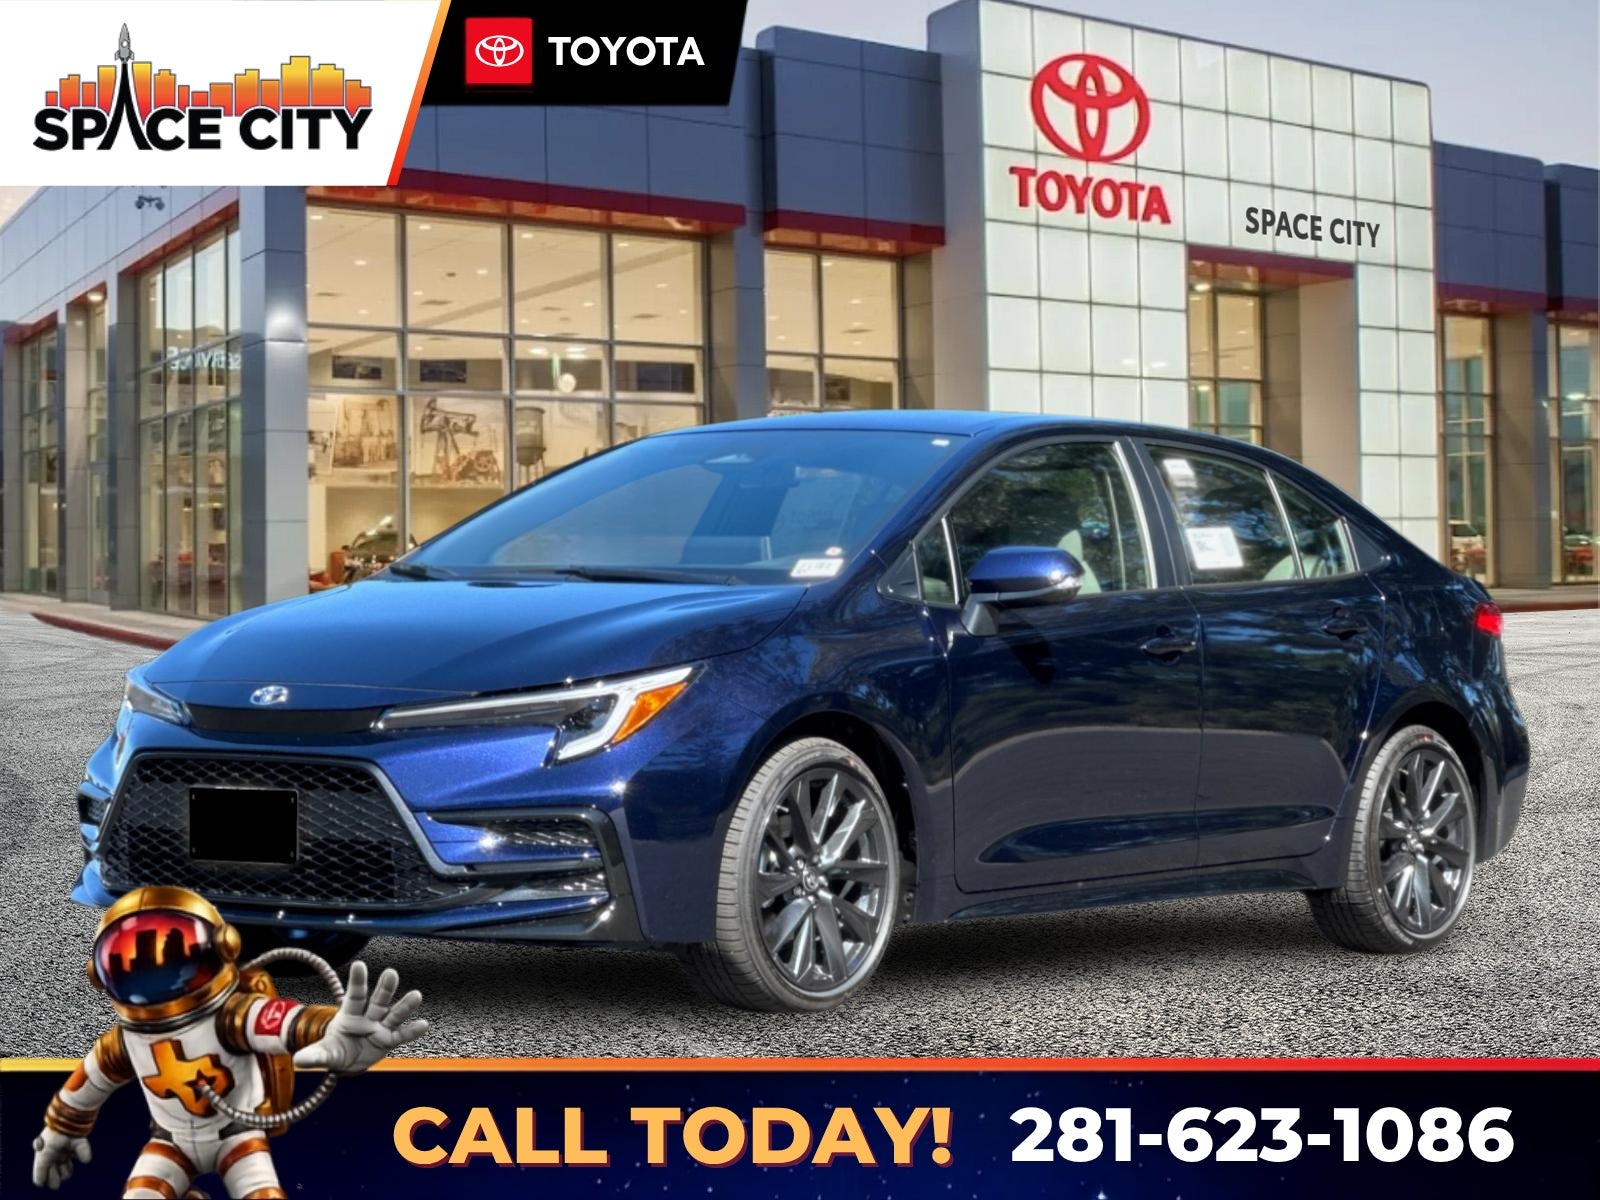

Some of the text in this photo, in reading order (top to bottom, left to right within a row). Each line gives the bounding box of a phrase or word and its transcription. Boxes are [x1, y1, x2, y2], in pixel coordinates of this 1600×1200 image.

[1009, 166, 1171, 224] TOYOTA
[1245, 206, 1381, 248] SPACE CITY
